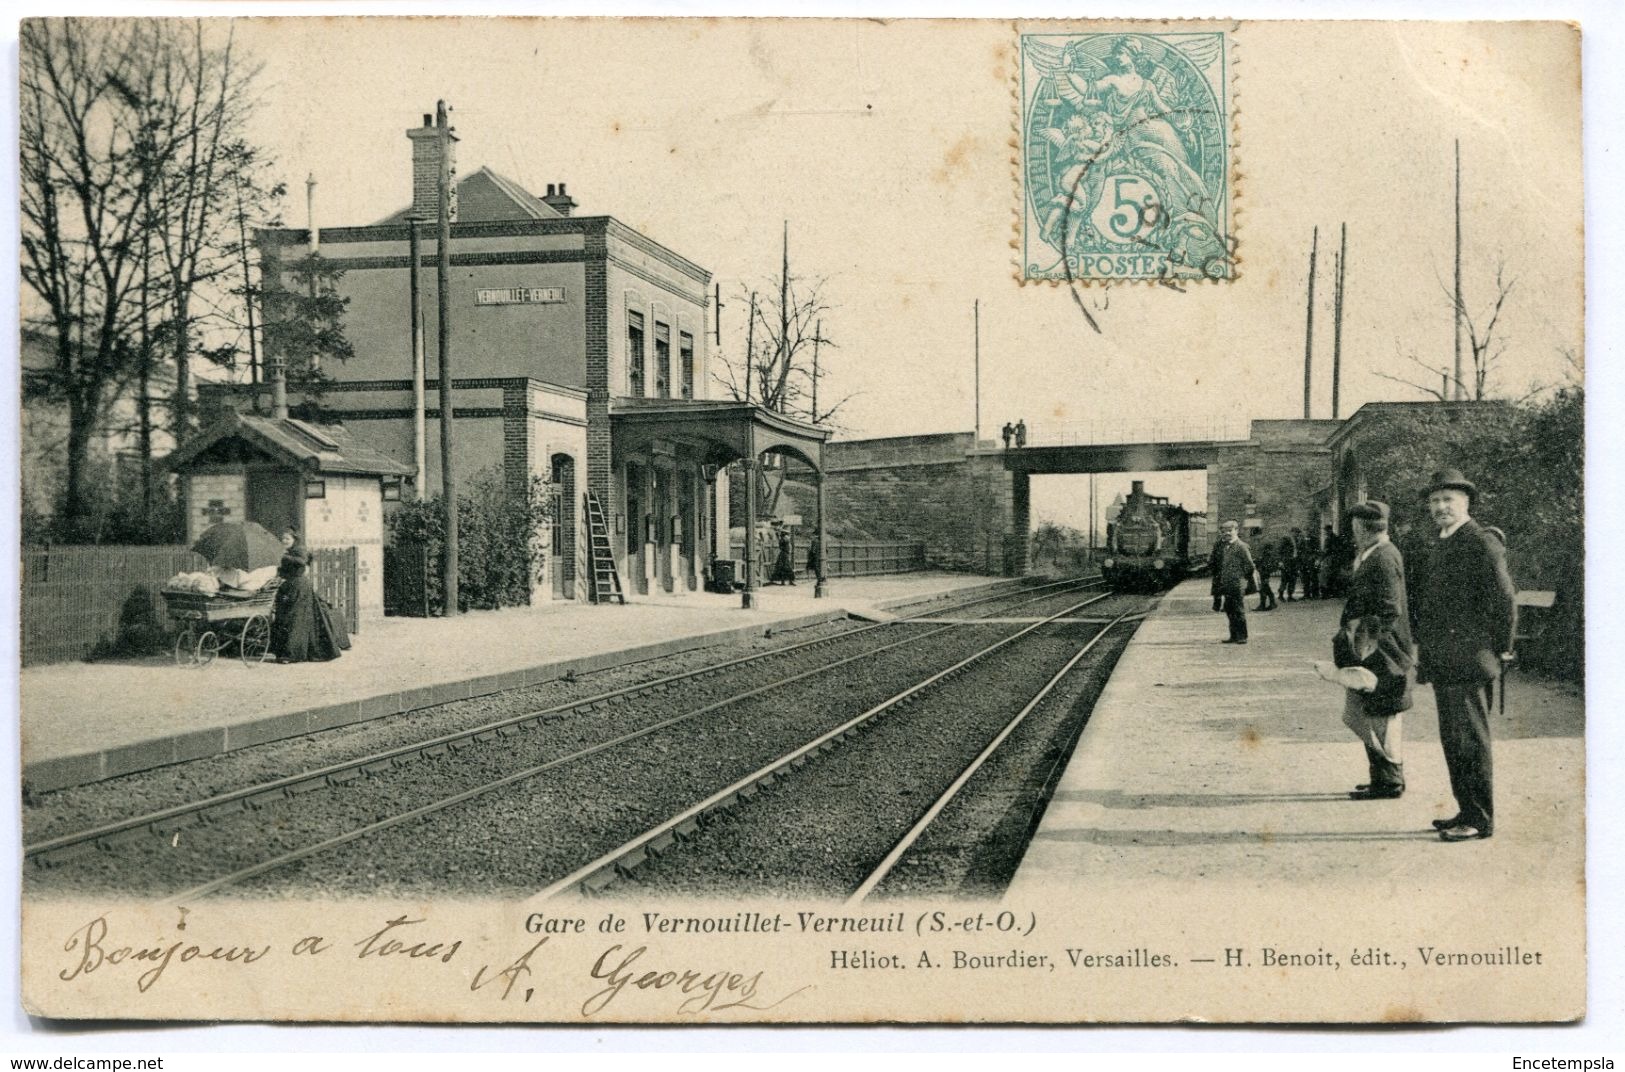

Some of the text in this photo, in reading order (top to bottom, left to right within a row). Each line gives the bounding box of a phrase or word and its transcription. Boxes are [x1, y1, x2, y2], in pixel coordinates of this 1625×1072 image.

[1082, 254, 1169, 277] POSTES
[525, 911, 1037, 937] Gare de Vernouillet-Verneuil (S.-et-O.)
[59, 906, 273, 993] Bonjour
[353, 914, 462, 963] tous
[830, 949, 906, 970] Héliot.
[917, 950, 942, 969] A.
[952, 949, 1055, 972] Bourdier,
[1066, 948, 1178, 968] Versailles.
[1225, 948, 1251, 967] H.
[1262, 948, 1340, 970] Benoit,
[1350, 947, 1407, 970] édit.,
[1418, 946, 1542, 966] Vernouillet
[581, 944, 770, 1018] Georges
